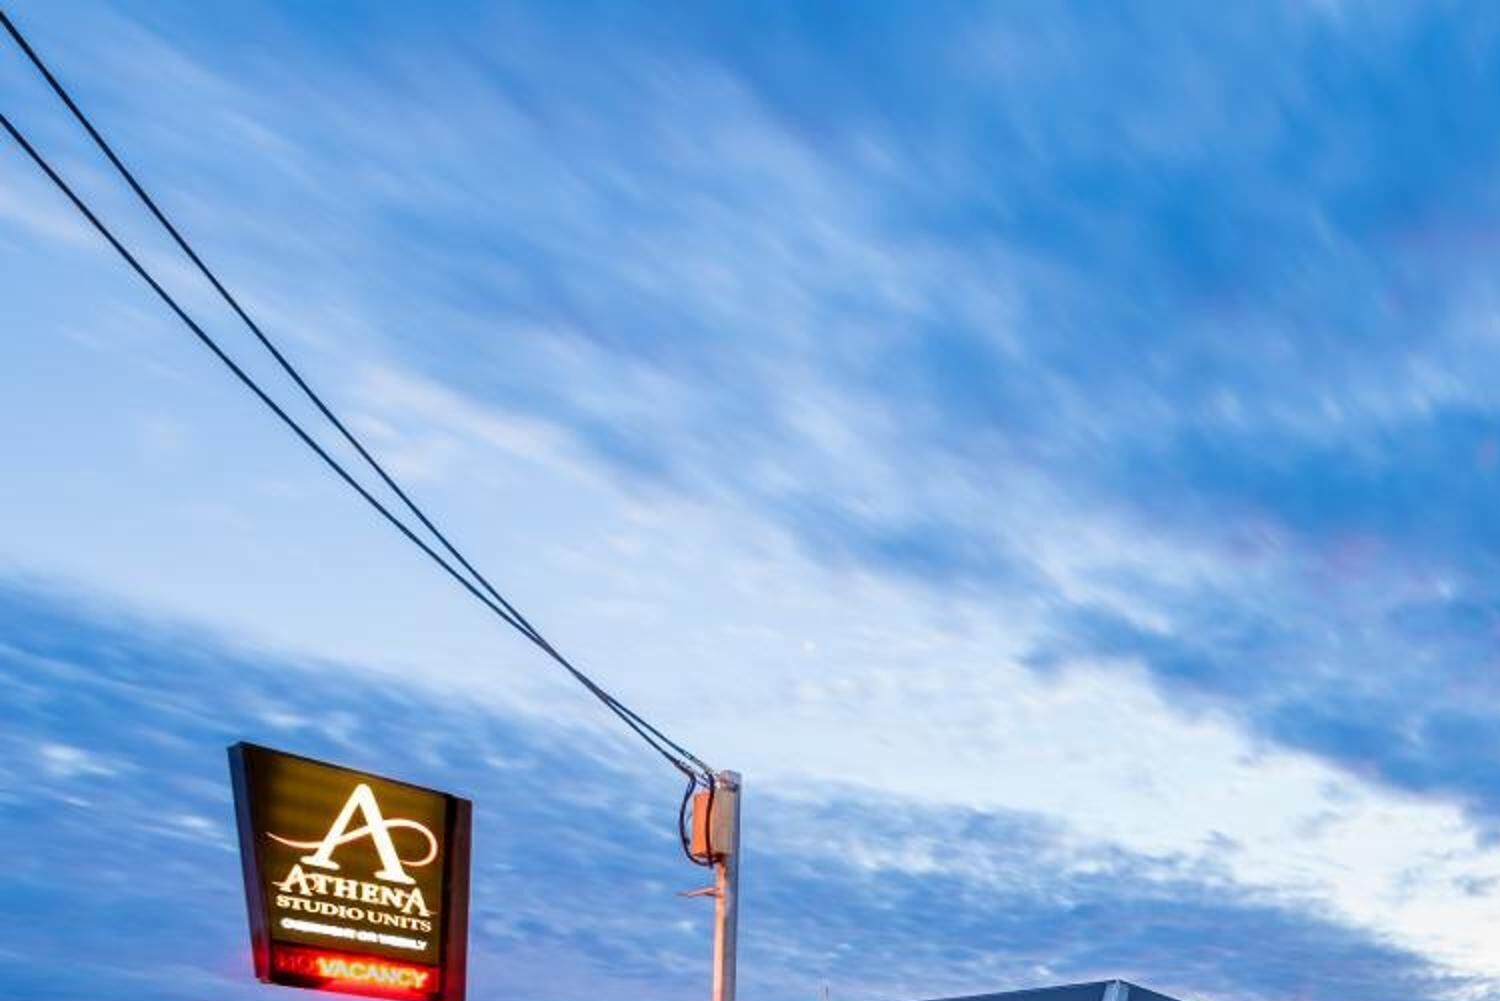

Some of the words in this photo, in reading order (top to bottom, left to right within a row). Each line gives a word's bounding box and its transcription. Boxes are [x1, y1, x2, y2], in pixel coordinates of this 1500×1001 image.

[272, 864, 437, 917] ATHENA
[276, 894, 364, 920] STUDIO
[367, 911, 432, 932] UNITS
[316, 957, 429, 989] VACANCY
